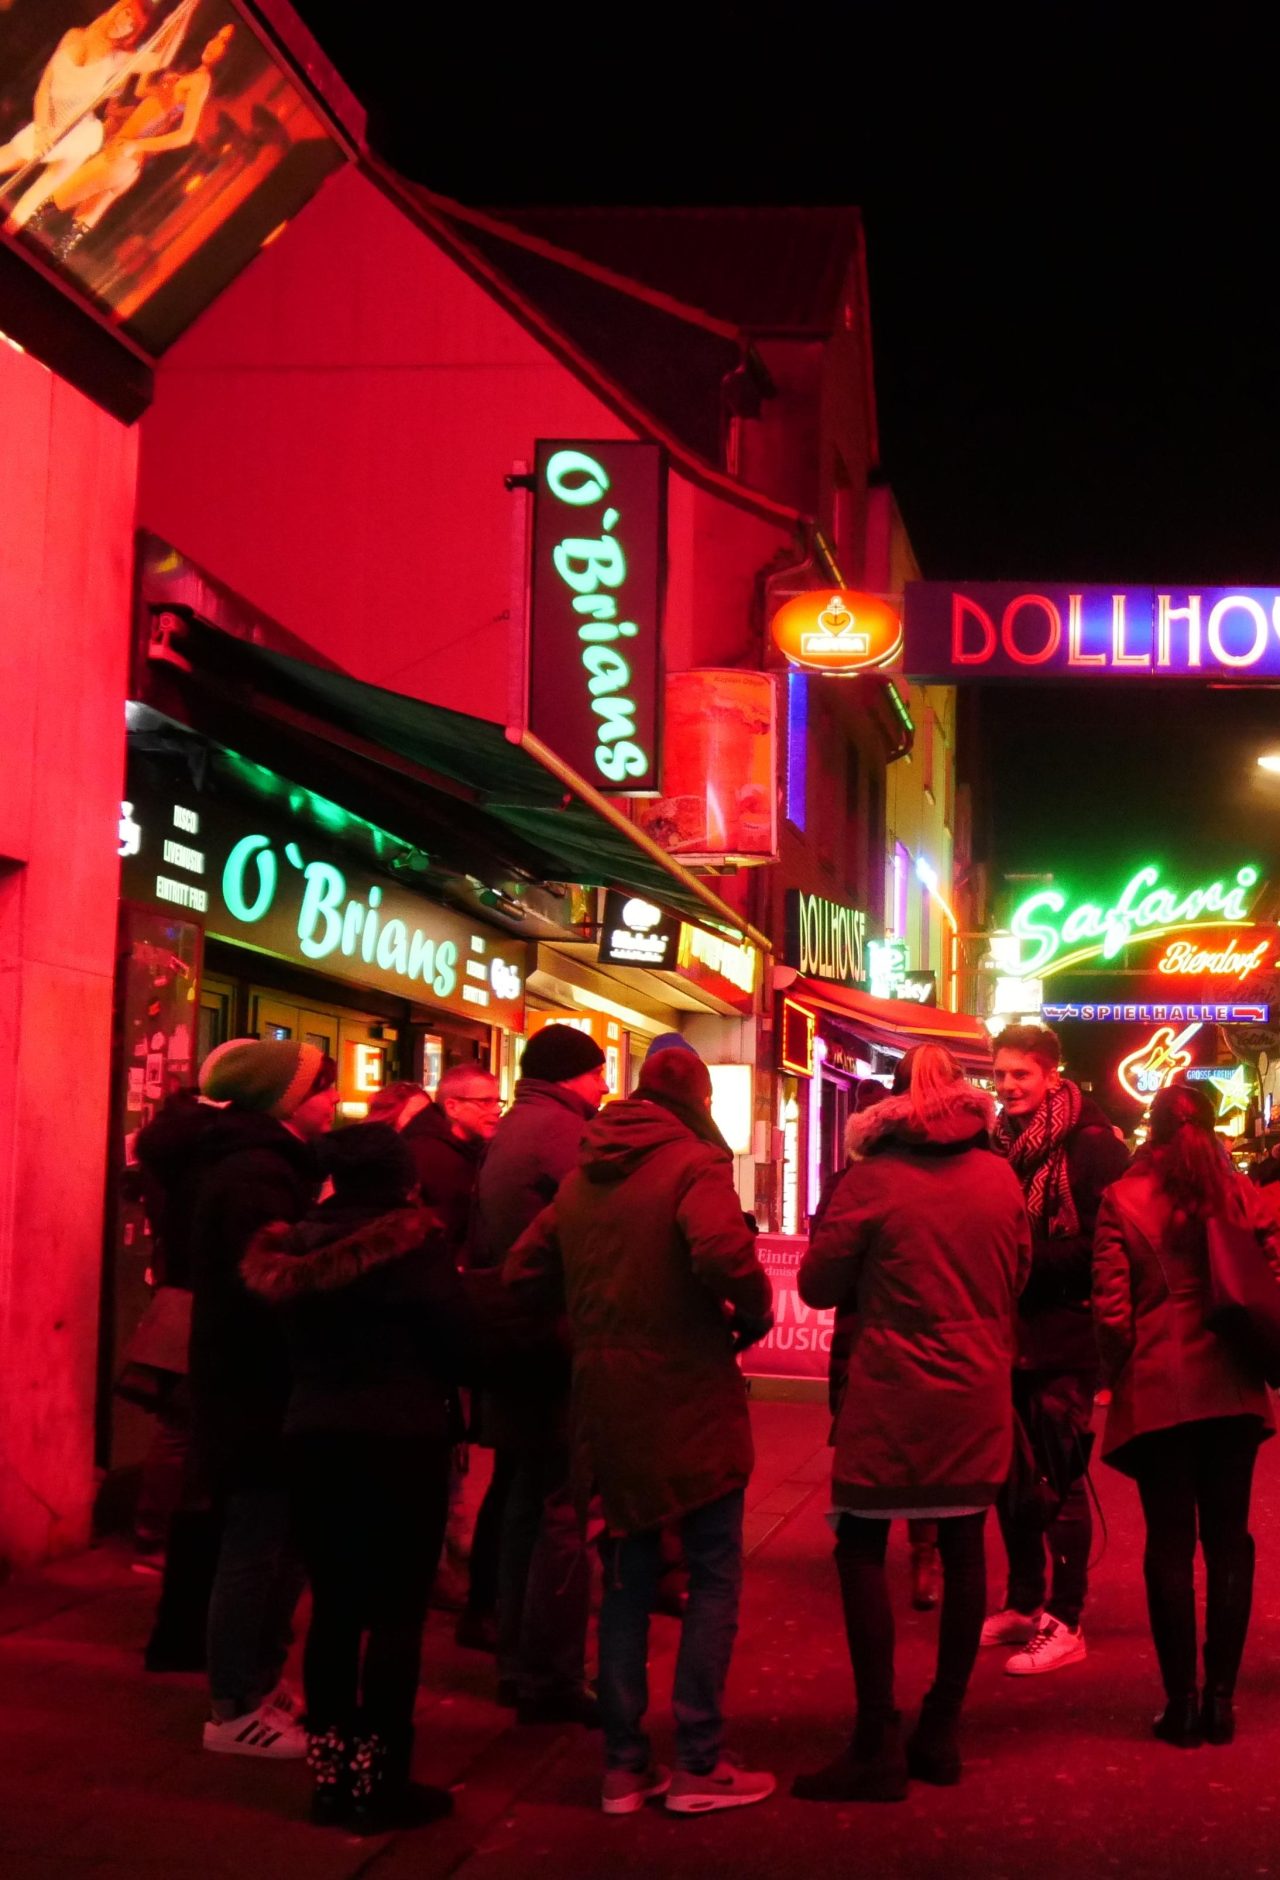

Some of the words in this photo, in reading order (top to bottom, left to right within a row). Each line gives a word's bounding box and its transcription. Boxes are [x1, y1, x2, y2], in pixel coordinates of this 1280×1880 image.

[799, 890, 866, 982] DOLLHOUSE
[1000, 866, 1258, 977] Safari
[1158, 938, 1269, 980] Bierdorf
[1081, 1005, 1228, 1020] SPIELHALLE
